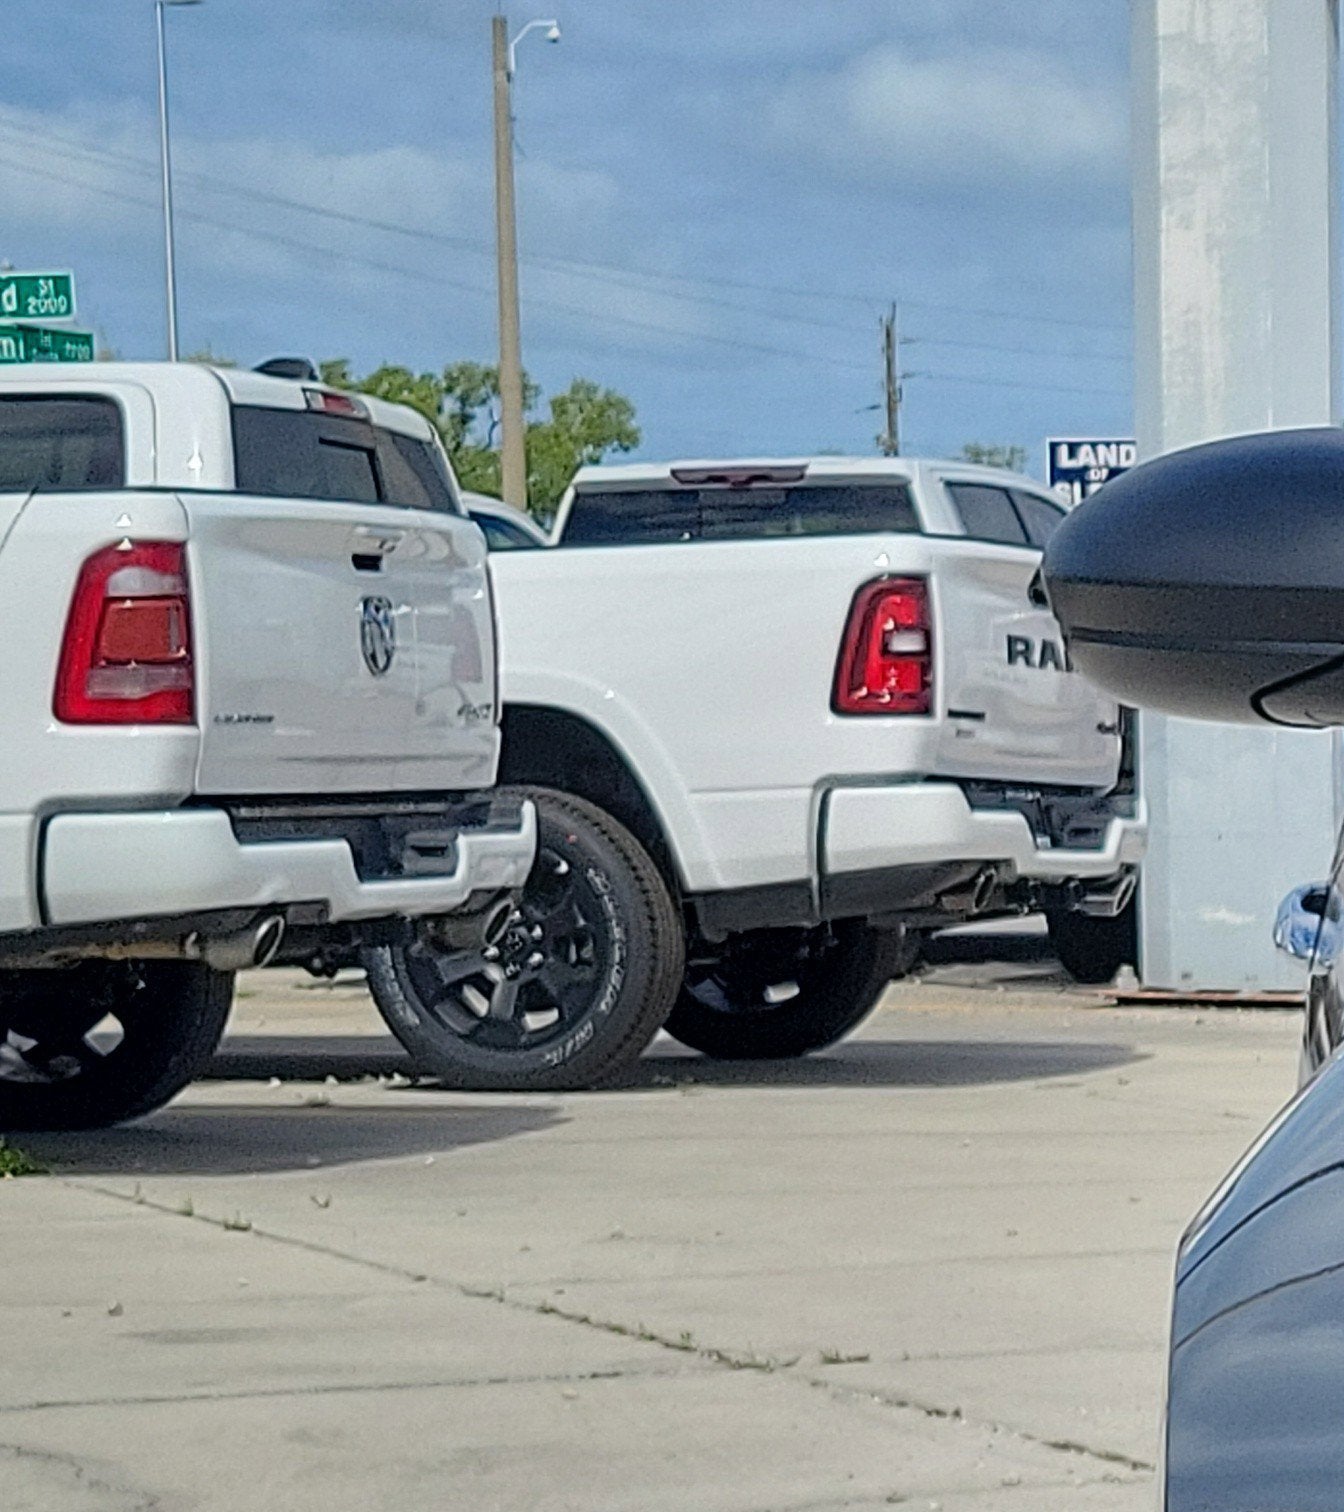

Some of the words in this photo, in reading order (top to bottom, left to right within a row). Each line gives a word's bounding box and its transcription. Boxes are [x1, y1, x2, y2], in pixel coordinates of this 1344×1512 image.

[27, 295, 67, 314] 2000
[1056, 443, 1136, 468] LAND
[1006, 634, 1074, 673] RA
